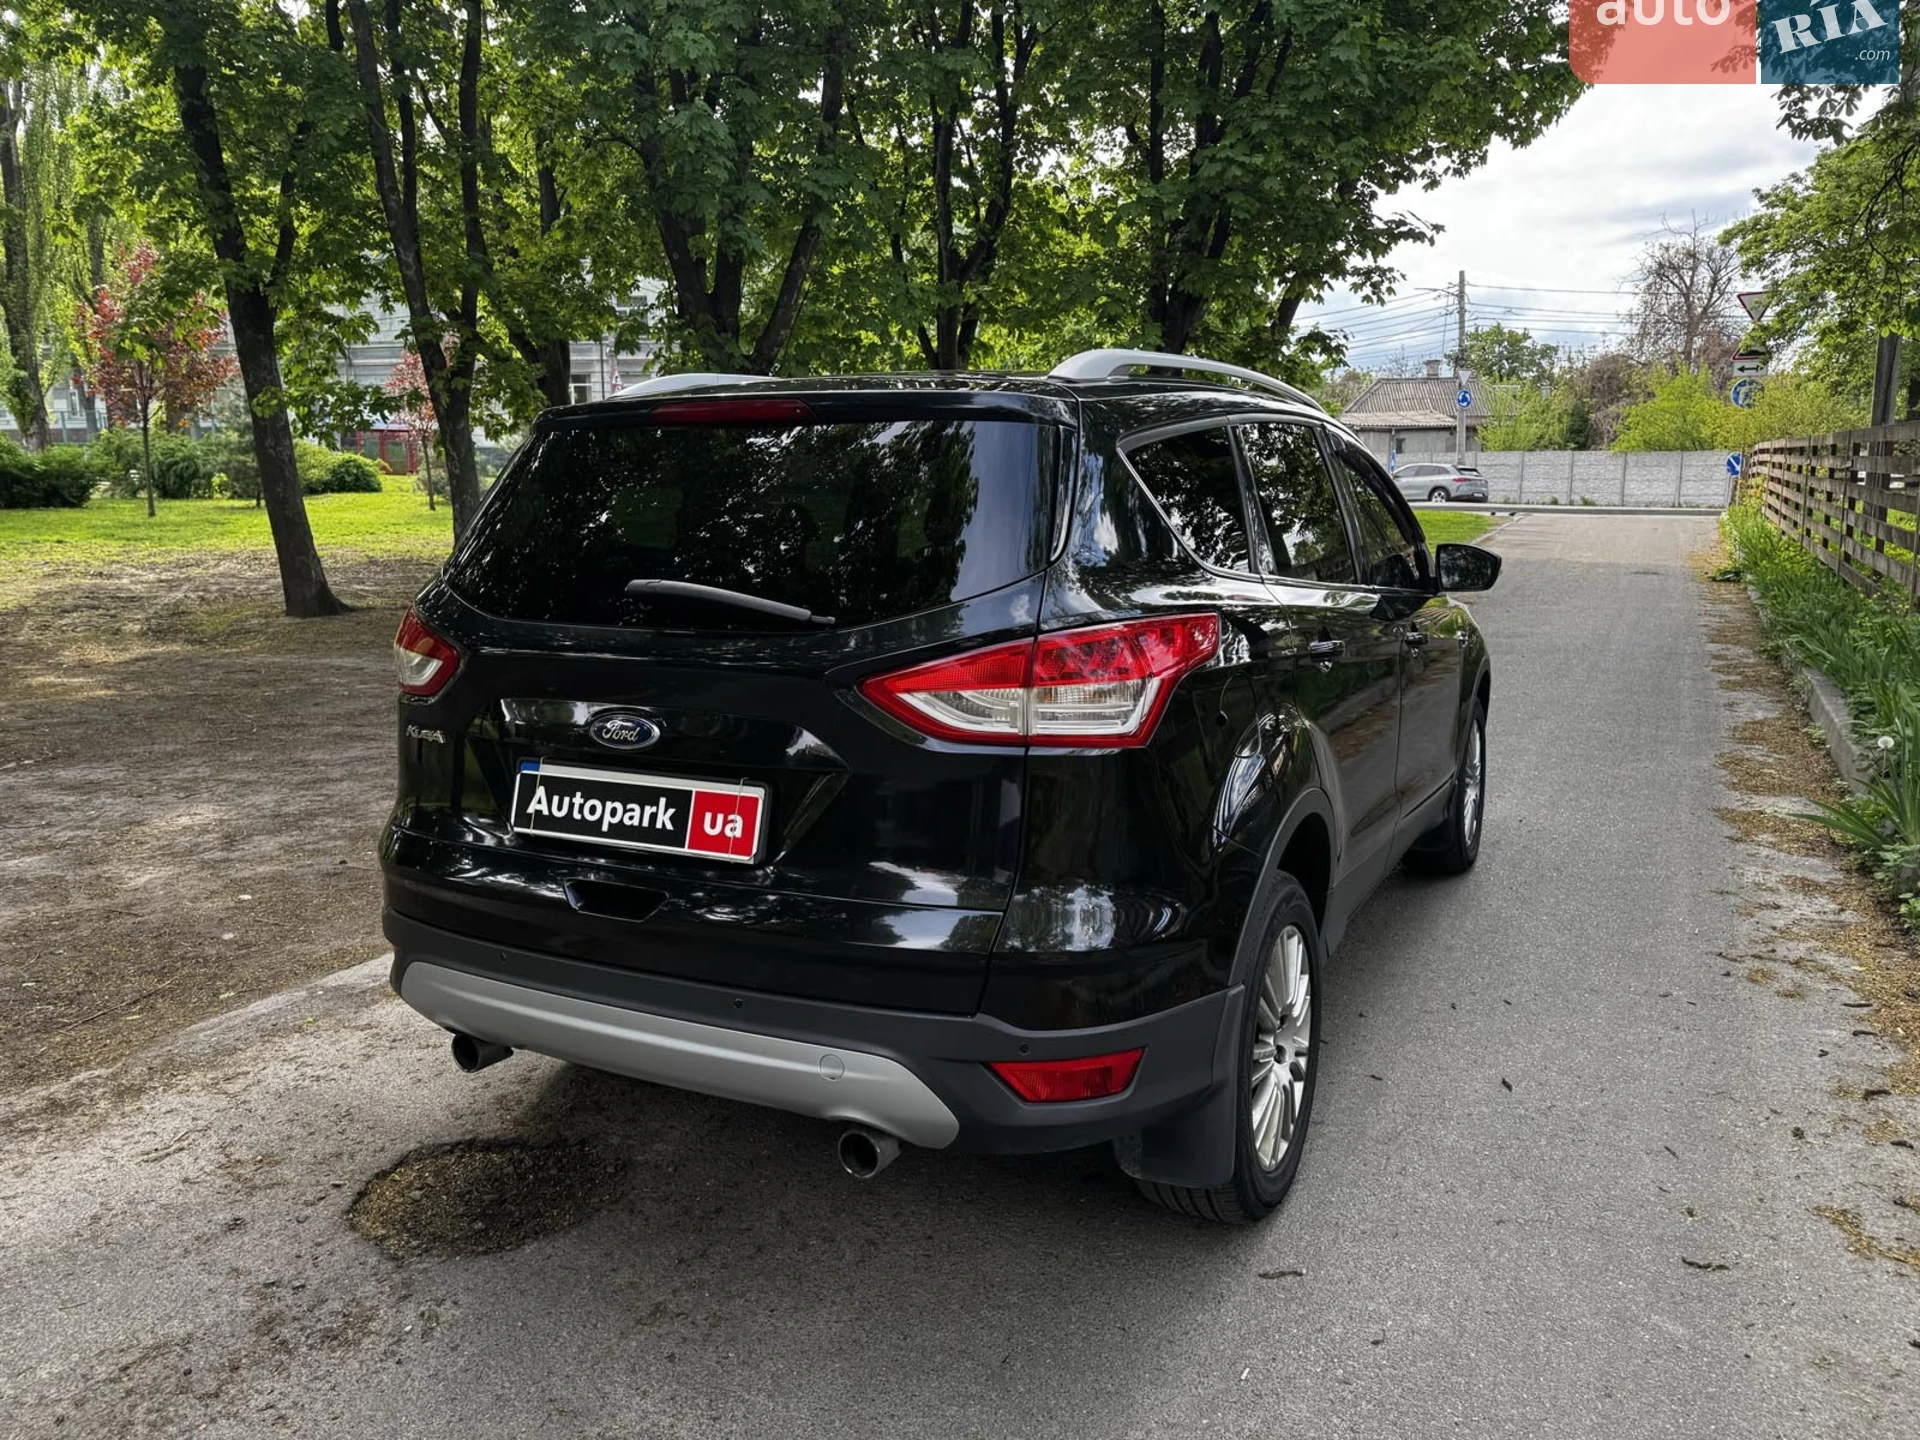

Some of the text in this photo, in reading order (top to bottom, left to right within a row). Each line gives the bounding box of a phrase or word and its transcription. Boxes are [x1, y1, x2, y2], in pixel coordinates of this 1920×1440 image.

[601, 719, 641, 741] Ford
[526, 785, 744, 839] Autopark ua
